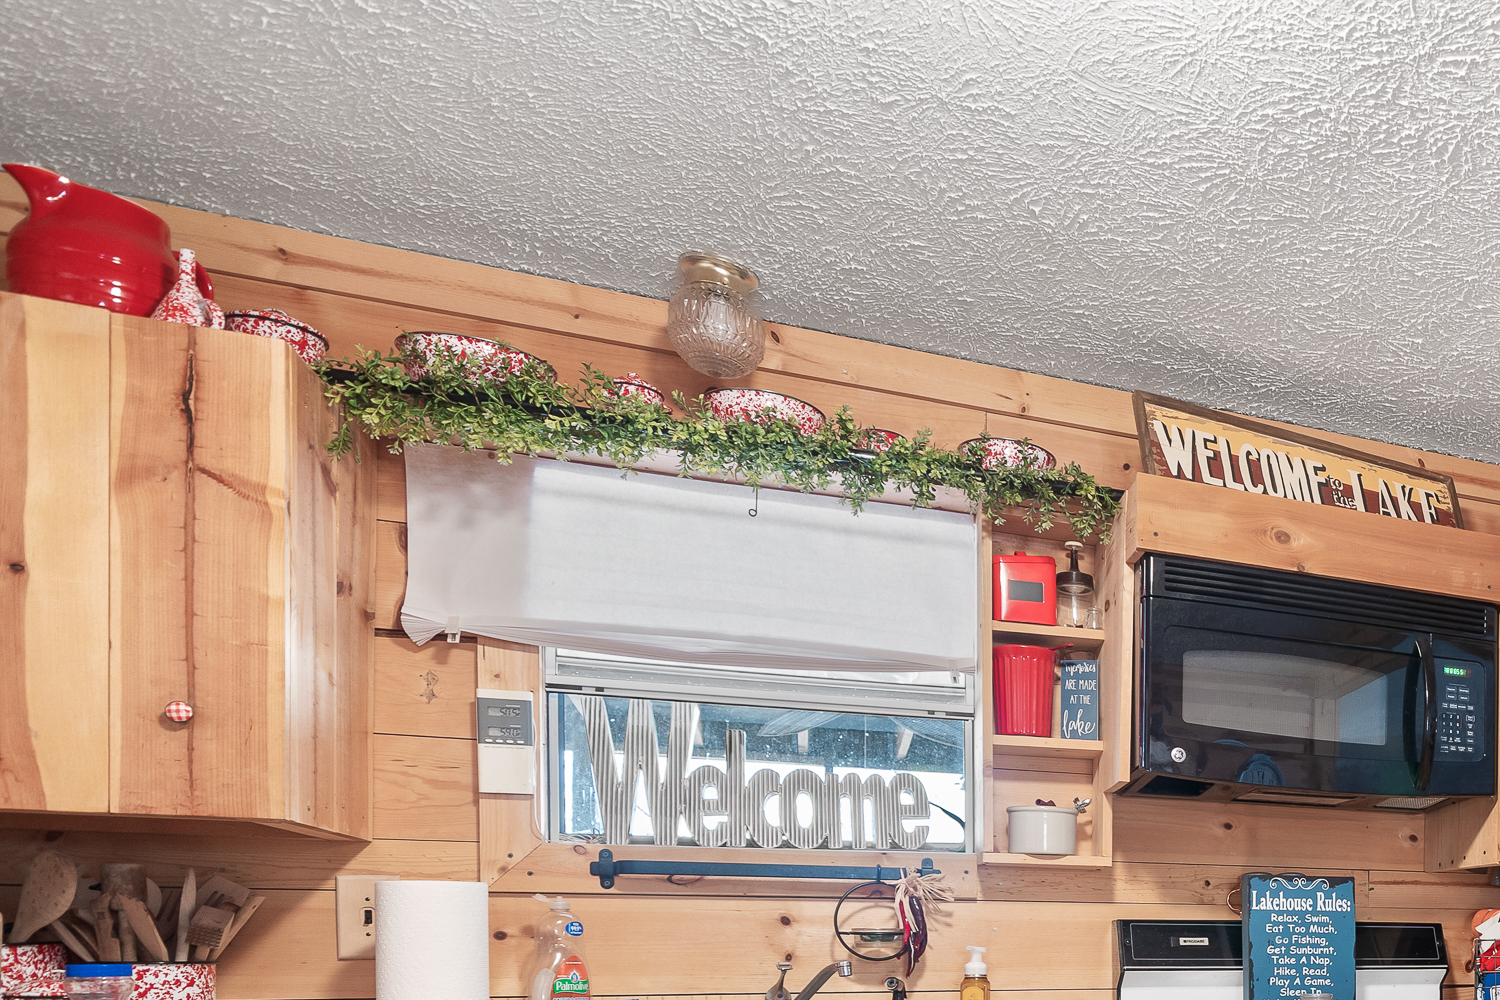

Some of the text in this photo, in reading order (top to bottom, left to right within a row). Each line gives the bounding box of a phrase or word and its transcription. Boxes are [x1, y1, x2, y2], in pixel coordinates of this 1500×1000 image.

[1153, 419, 1327, 504] WELCOME
[1327, 474, 1343, 492] to
[1332, 490, 1357, 510] the
[1065, 662, 1096, 676] memories
[1065, 679, 1097, 691] ARE MADE
[1069, 694, 1091, 705] AT THE
[1062, 708, 1096, 739] lake
[580, 695, 930, 849] Welcome
[1252, 890, 1351, 912] Lakehouse Rules:
[1271, 914, 1333, 924] Relax, Swim,
[1266, 925, 1338, 935] Eat Too Much,
[1275, 935, 1329, 946] Go Fishing,
[1266, 946, 1337, 956] Get Sunburnt,
[1271, 956, 1333, 967] Take A Nap,
[1274, 967, 1330, 977] Hike, Read,
[556, 981, 589, 991] Palmolive
[1269, 977, 1290, 988] Play
[1304, 978, 1334, 987] Game,
